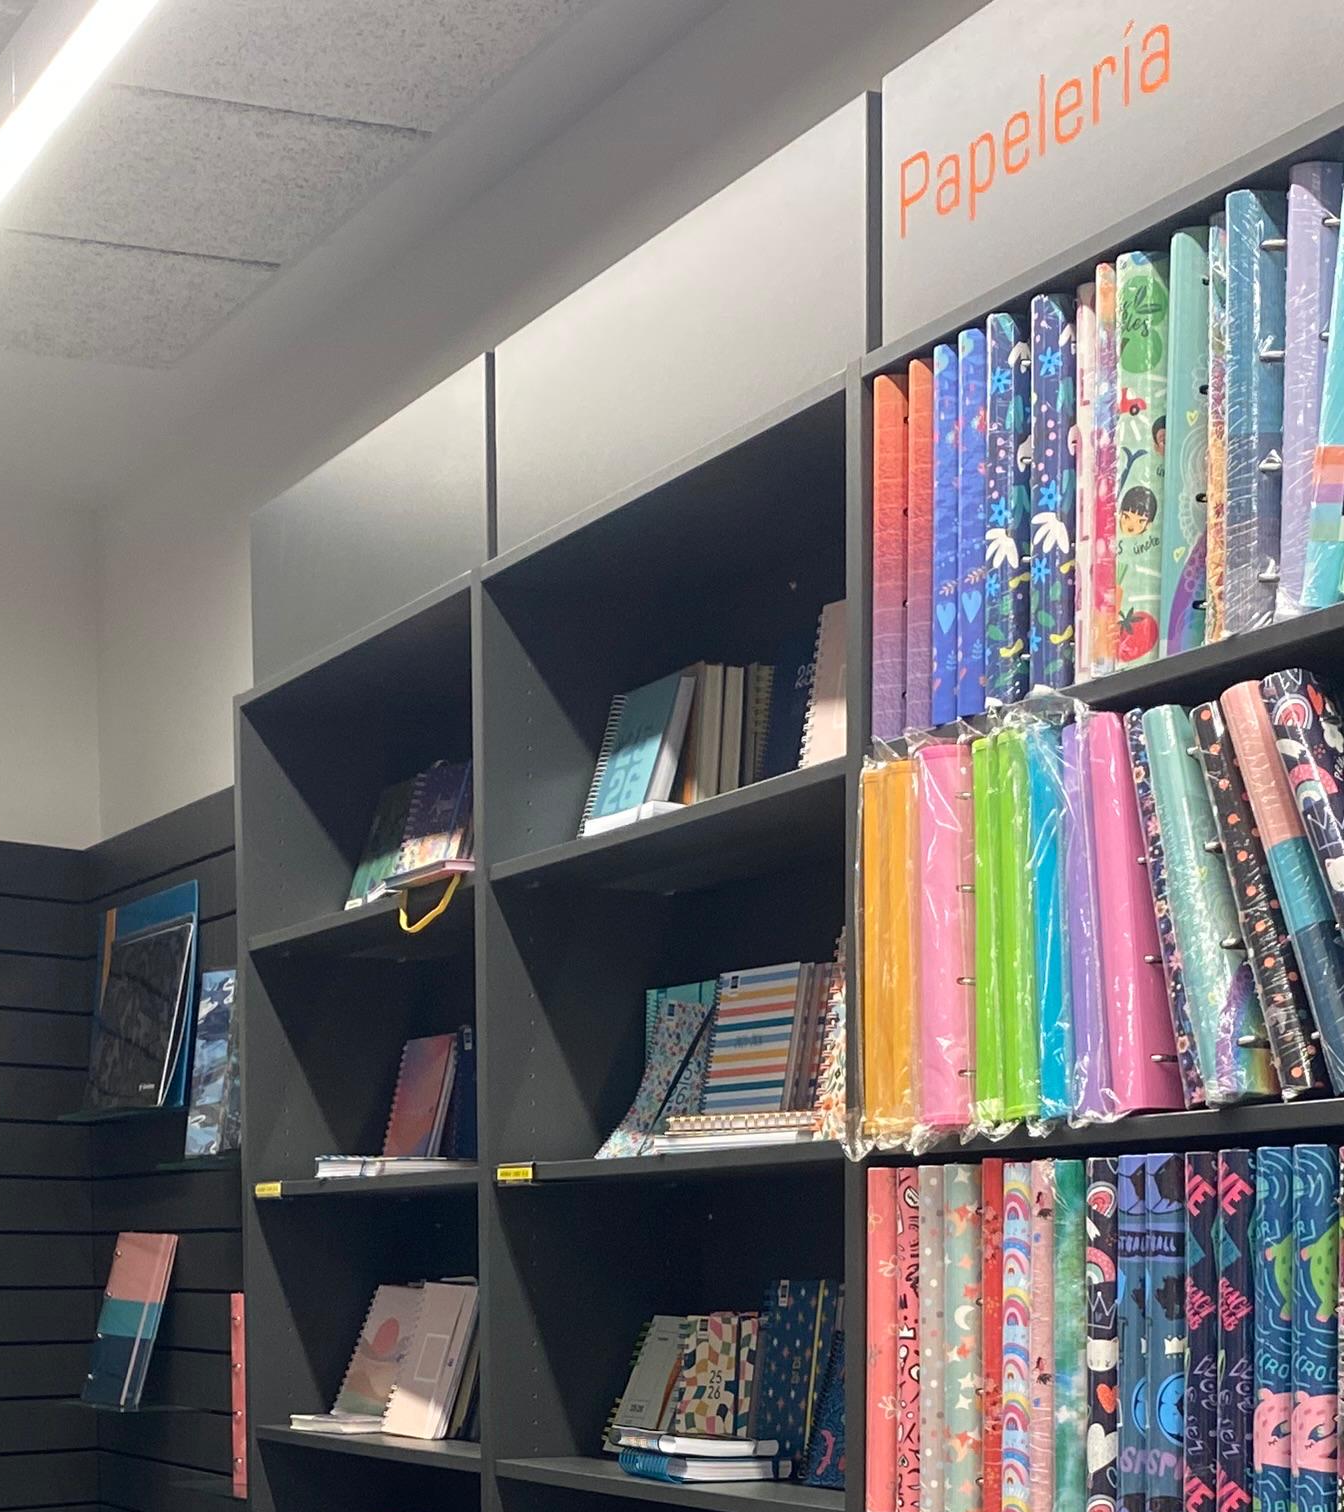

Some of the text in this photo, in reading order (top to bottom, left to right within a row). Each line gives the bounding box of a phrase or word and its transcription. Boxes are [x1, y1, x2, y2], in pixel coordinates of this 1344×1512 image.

[899, 18, 1171, 240] Papelería
[709, 1369, 723, 1386] 25
[706, 1385, 722, 1400] 26
